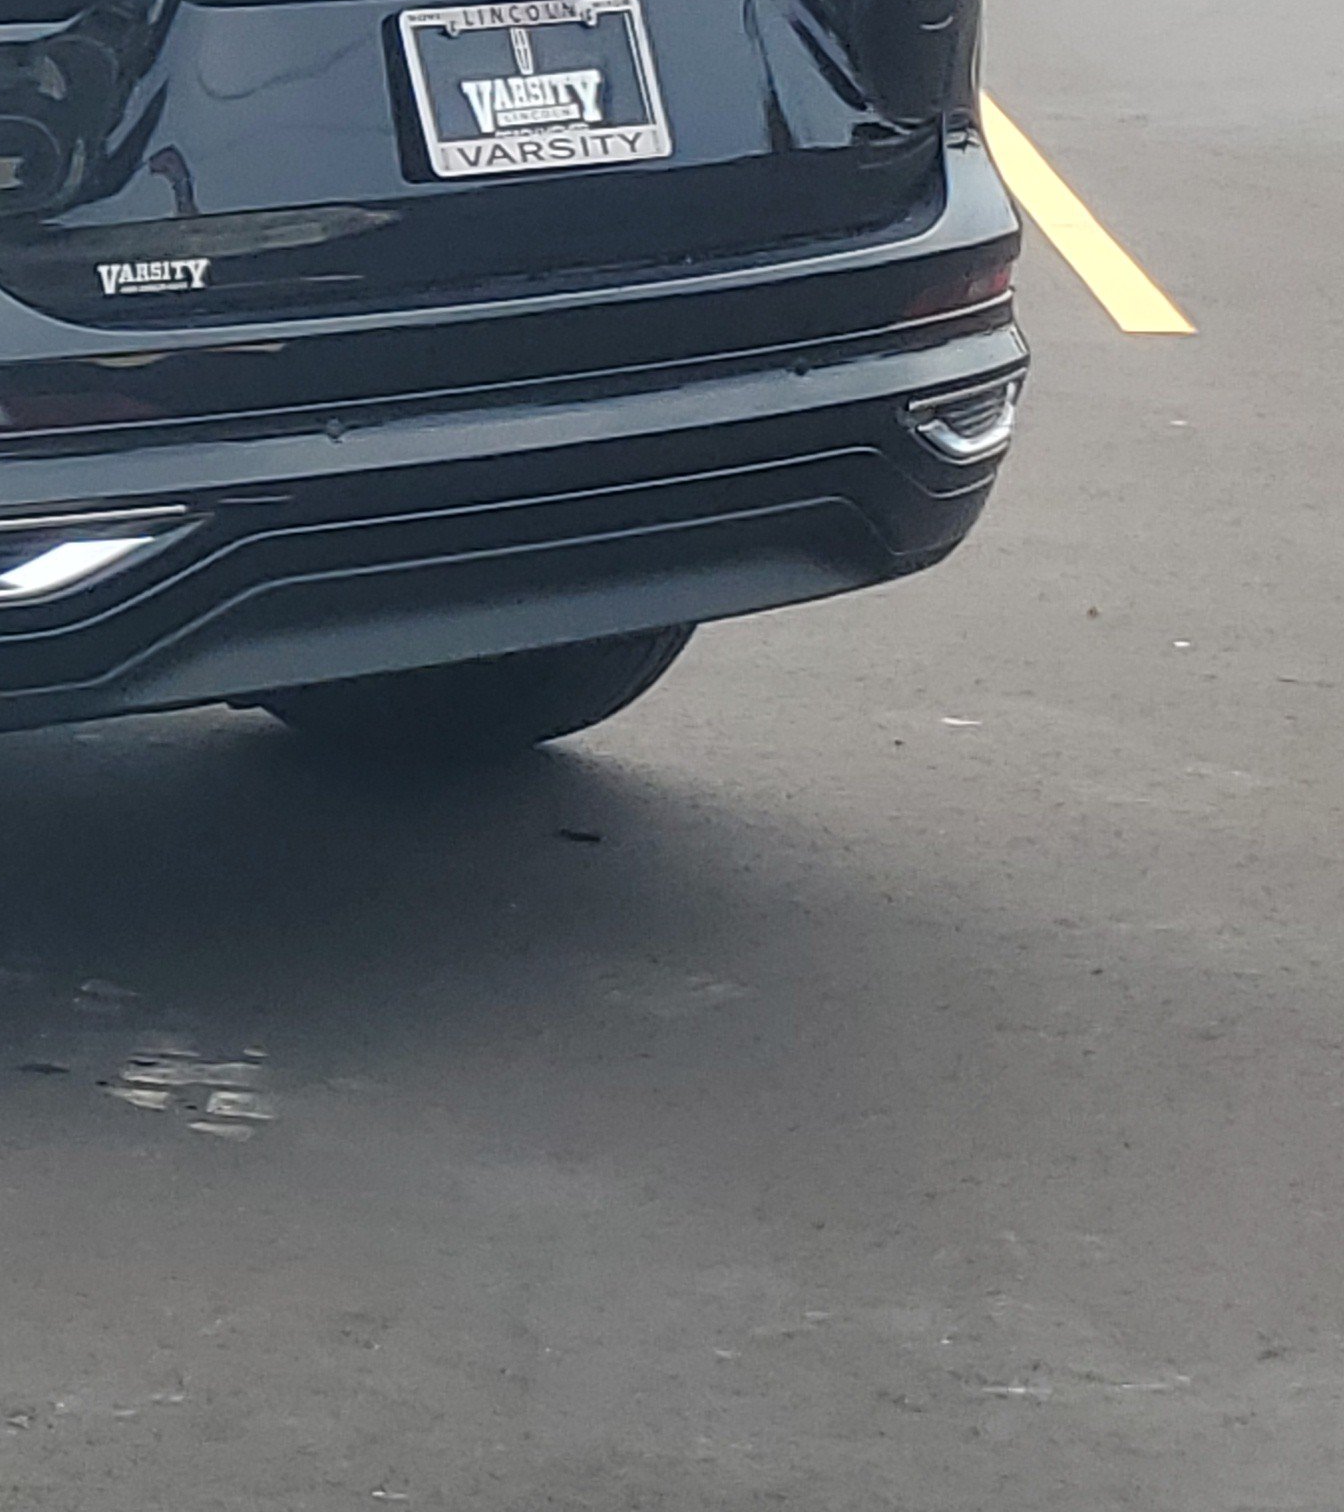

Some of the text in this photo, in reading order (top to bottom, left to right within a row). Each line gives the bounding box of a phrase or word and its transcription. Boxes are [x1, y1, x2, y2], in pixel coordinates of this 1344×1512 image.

[462, 2, 577, 26] LINCOLN
[461, 68, 603, 133] VARSITY
[457, 131, 643, 168] VARSITY
[97, 257, 211, 295] VARSITY
